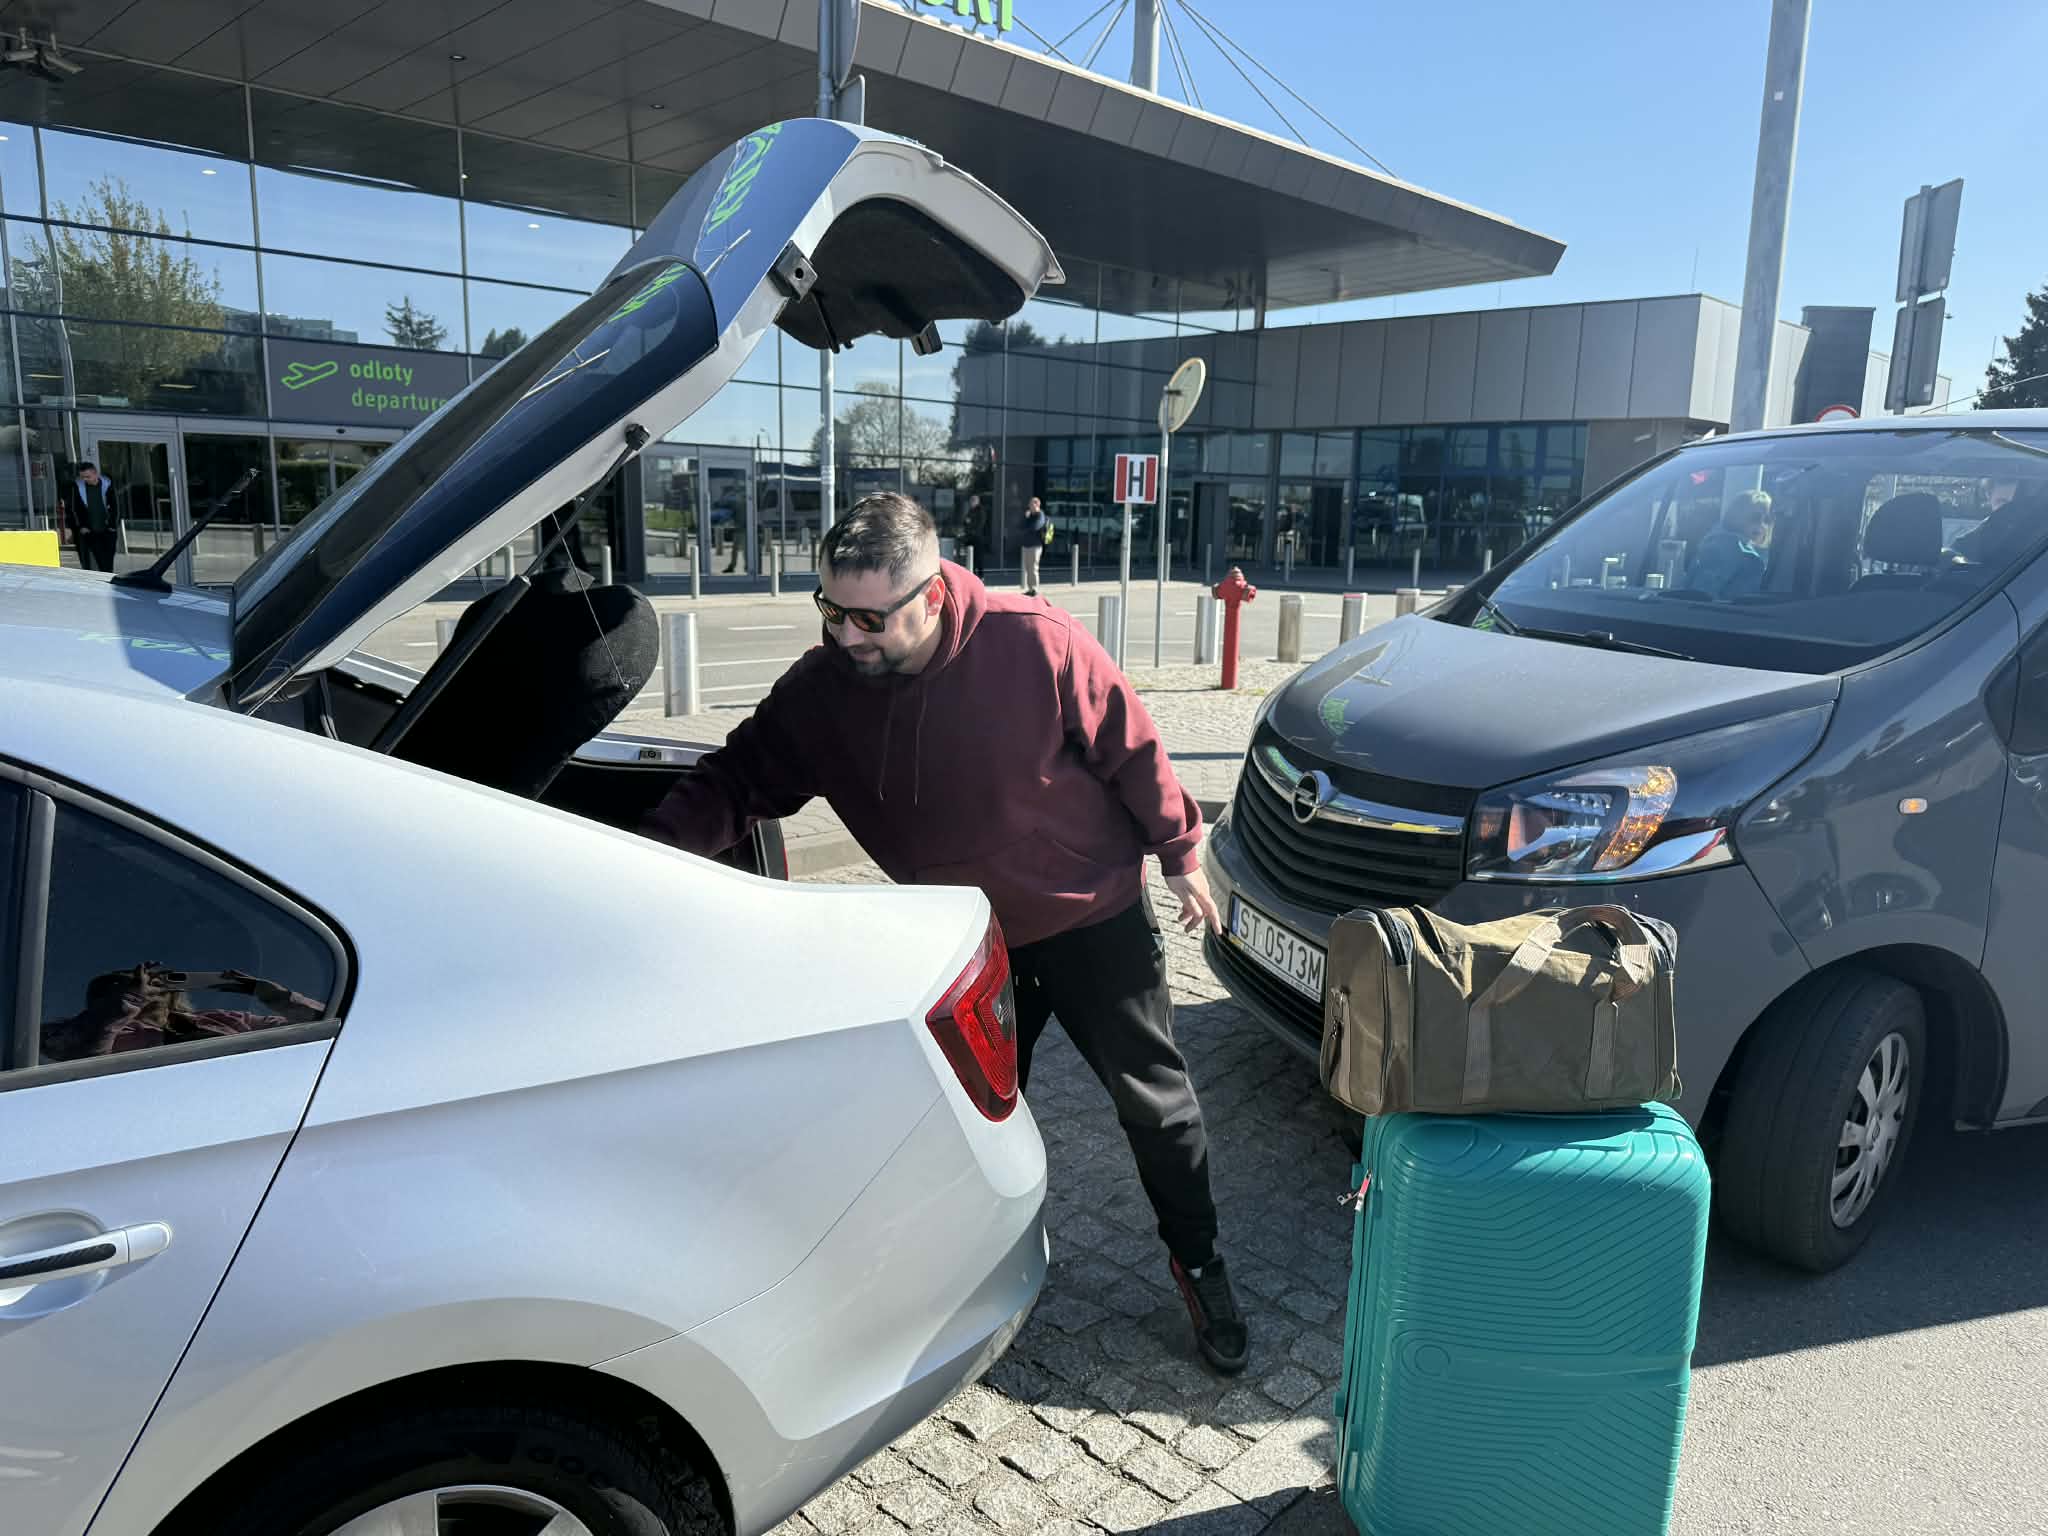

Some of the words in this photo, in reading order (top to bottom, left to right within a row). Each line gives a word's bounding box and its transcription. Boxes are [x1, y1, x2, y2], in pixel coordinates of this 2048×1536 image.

[350, 360, 413, 386] odloty
[1128, 461, 1145, 497] H
[1239, 907, 1261, 947] ST
[1265, 925, 1322, 990] 0513M
